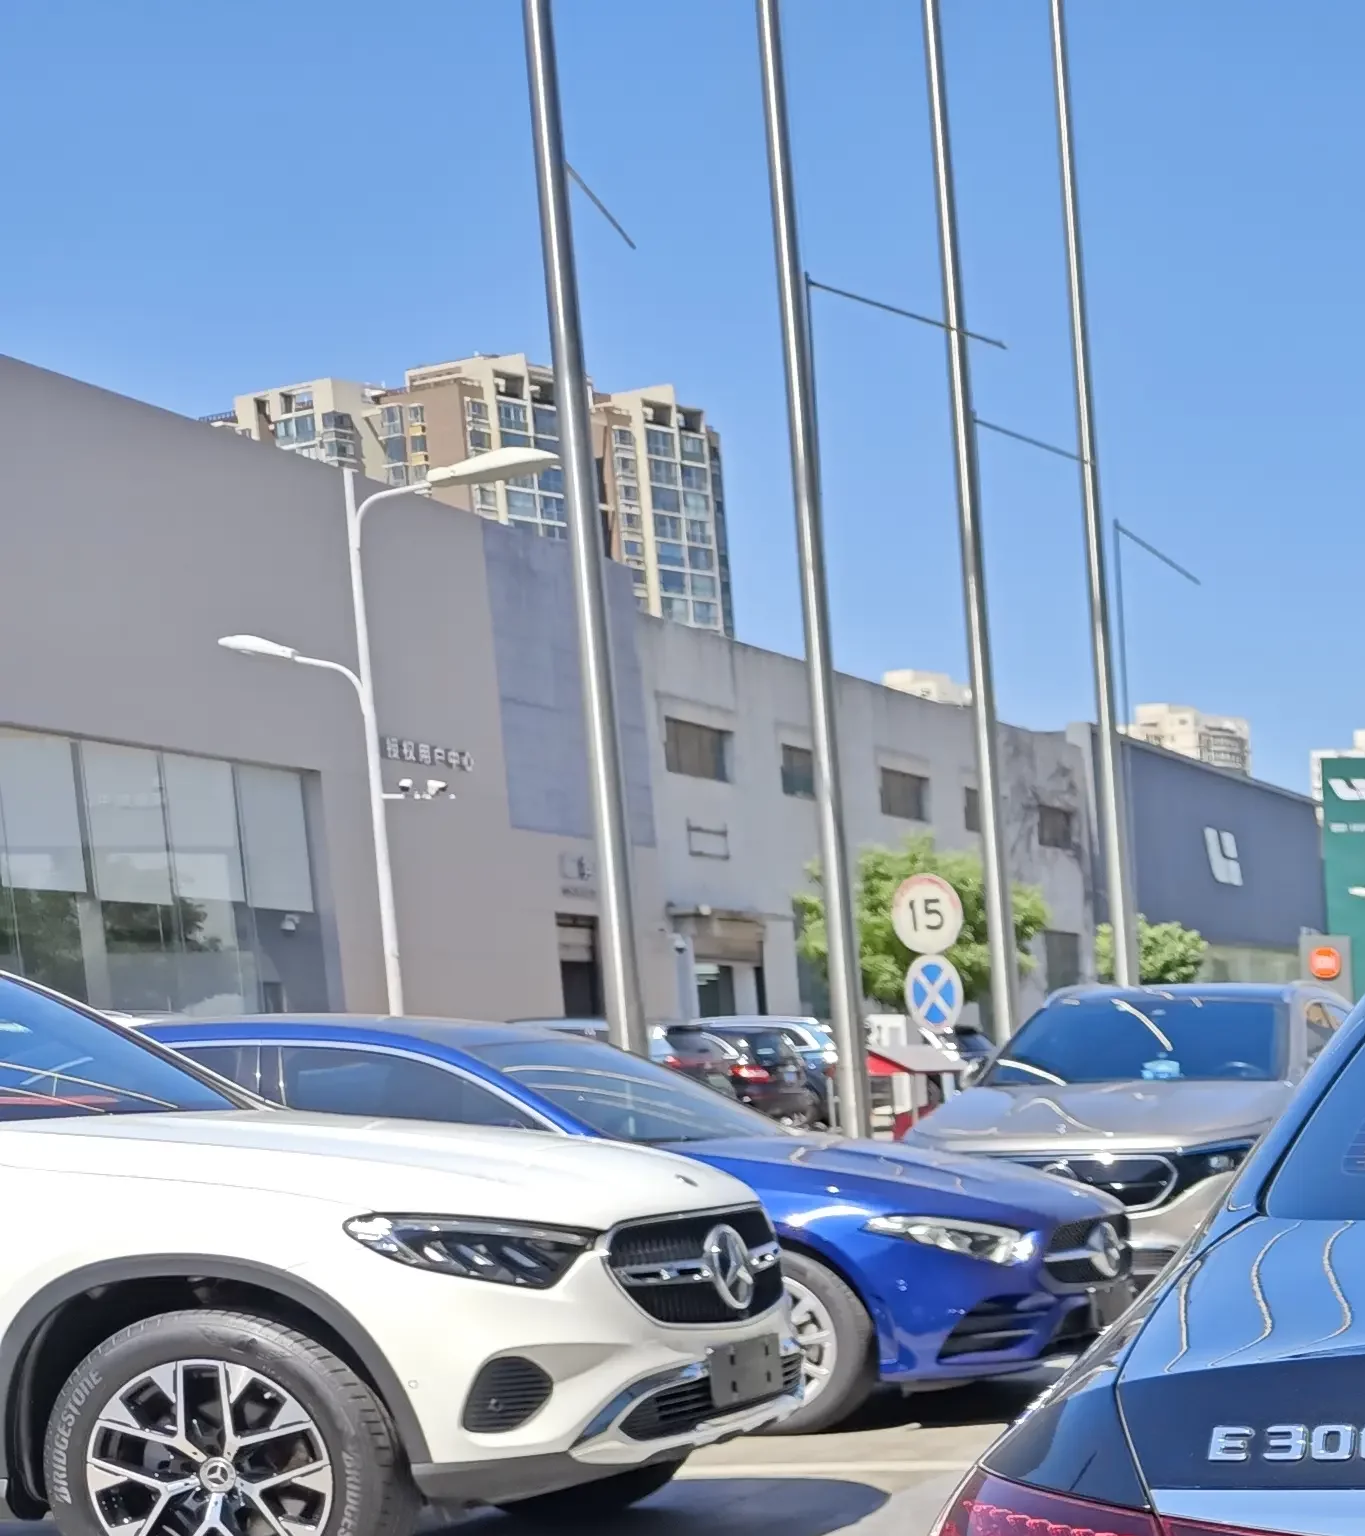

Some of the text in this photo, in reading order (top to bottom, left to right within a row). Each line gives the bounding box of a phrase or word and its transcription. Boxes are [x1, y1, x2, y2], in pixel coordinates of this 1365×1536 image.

[386, 737, 475, 772] 授权用户中心
[908, 898, 945, 932] 15
[51, 1368, 103, 1505] BRIDGESTONE
[1207, 1423, 1256, 1462] E
